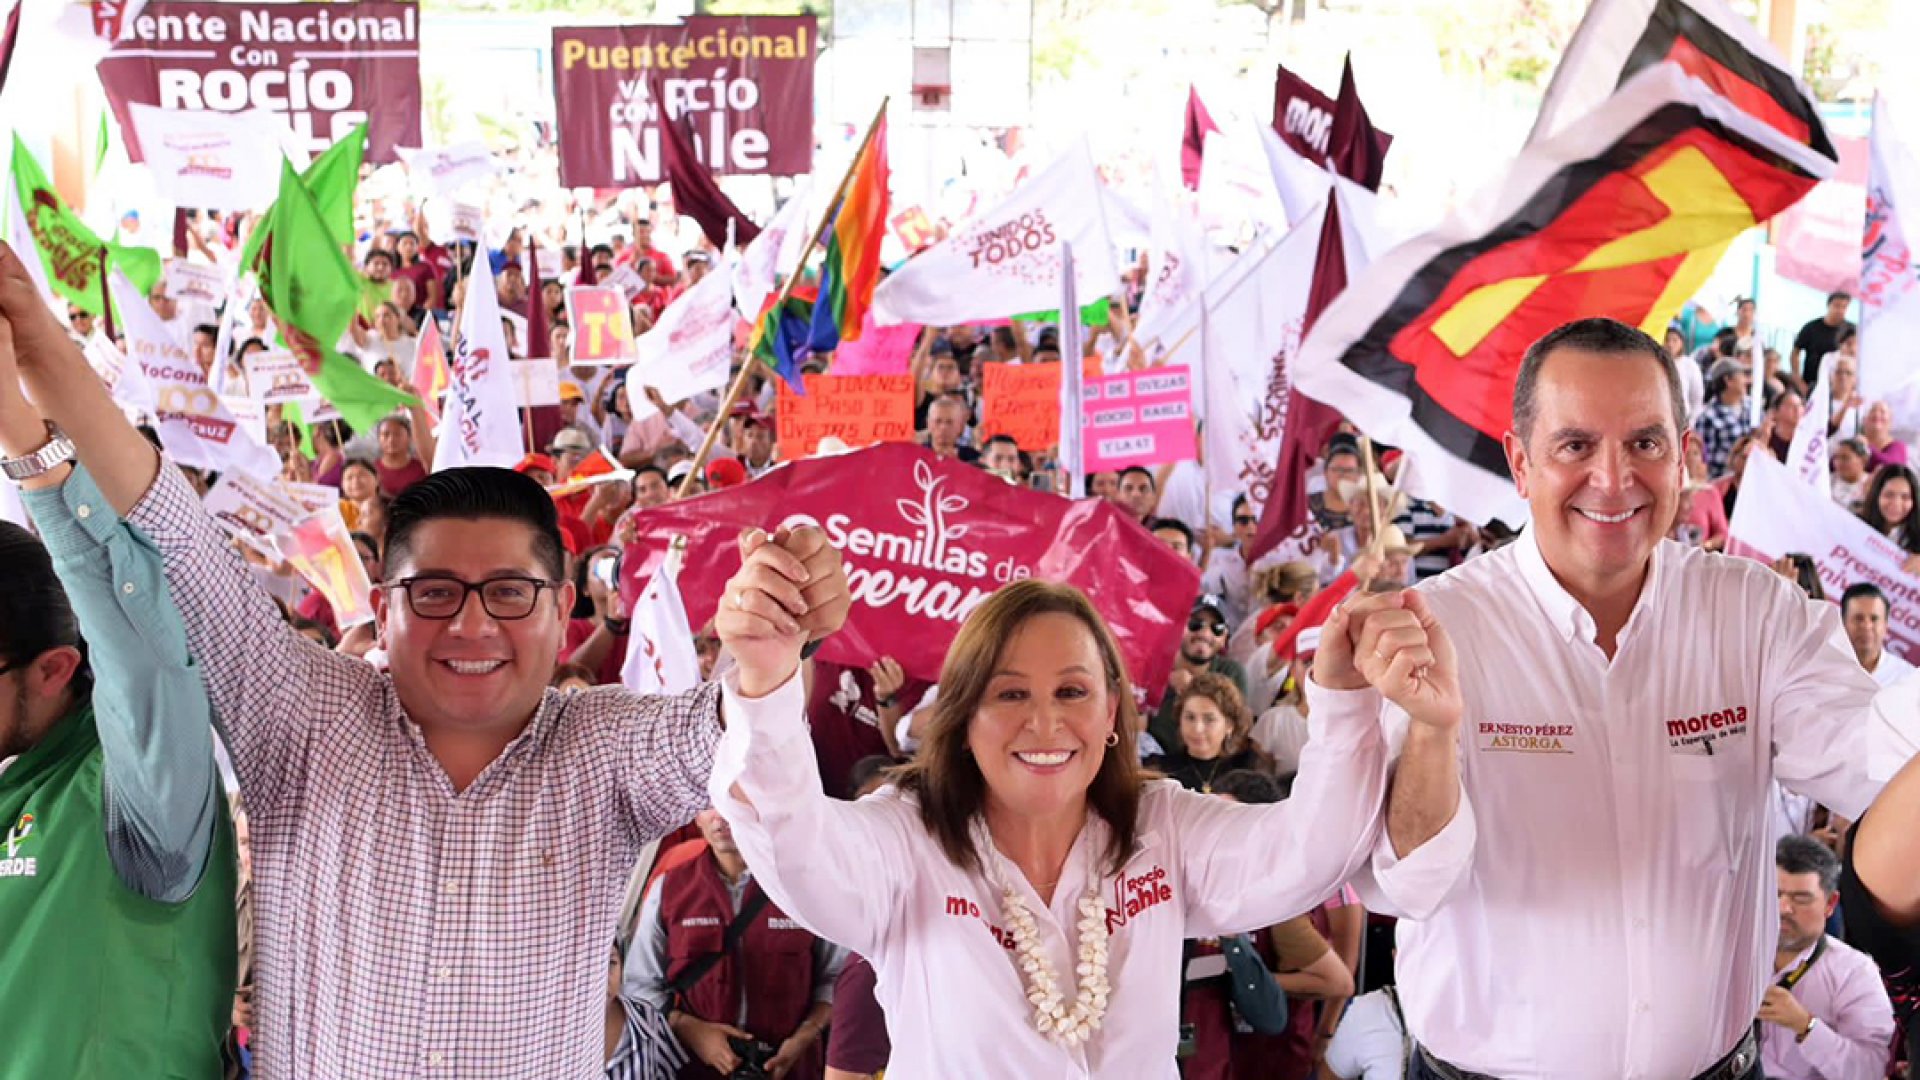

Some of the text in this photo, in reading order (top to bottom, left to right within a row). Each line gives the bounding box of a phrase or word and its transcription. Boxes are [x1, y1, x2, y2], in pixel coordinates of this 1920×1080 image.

[120, 7, 416, 42] ente Nacional
[230, 45, 278, 66] Con
[562, 26, 808, 69] Puente cional
[159, 59, 353, 112] ROCÍO
[609, 102, 658, 122] CON
[610, 112, 770, 181] Nle
[968, 223, 1056, 268] TODOS
[832, 374, 911, 394] JOVENES
[825, 514, 1031, 583] Semillas de
[1479, 722, 1574, 736] ERNESTO PÉREZ
[1666, 706, 1747, 736] morena
[1491, 735, 1563, 749] ASTORGA
[0, 856, 37, 877] ERDE
